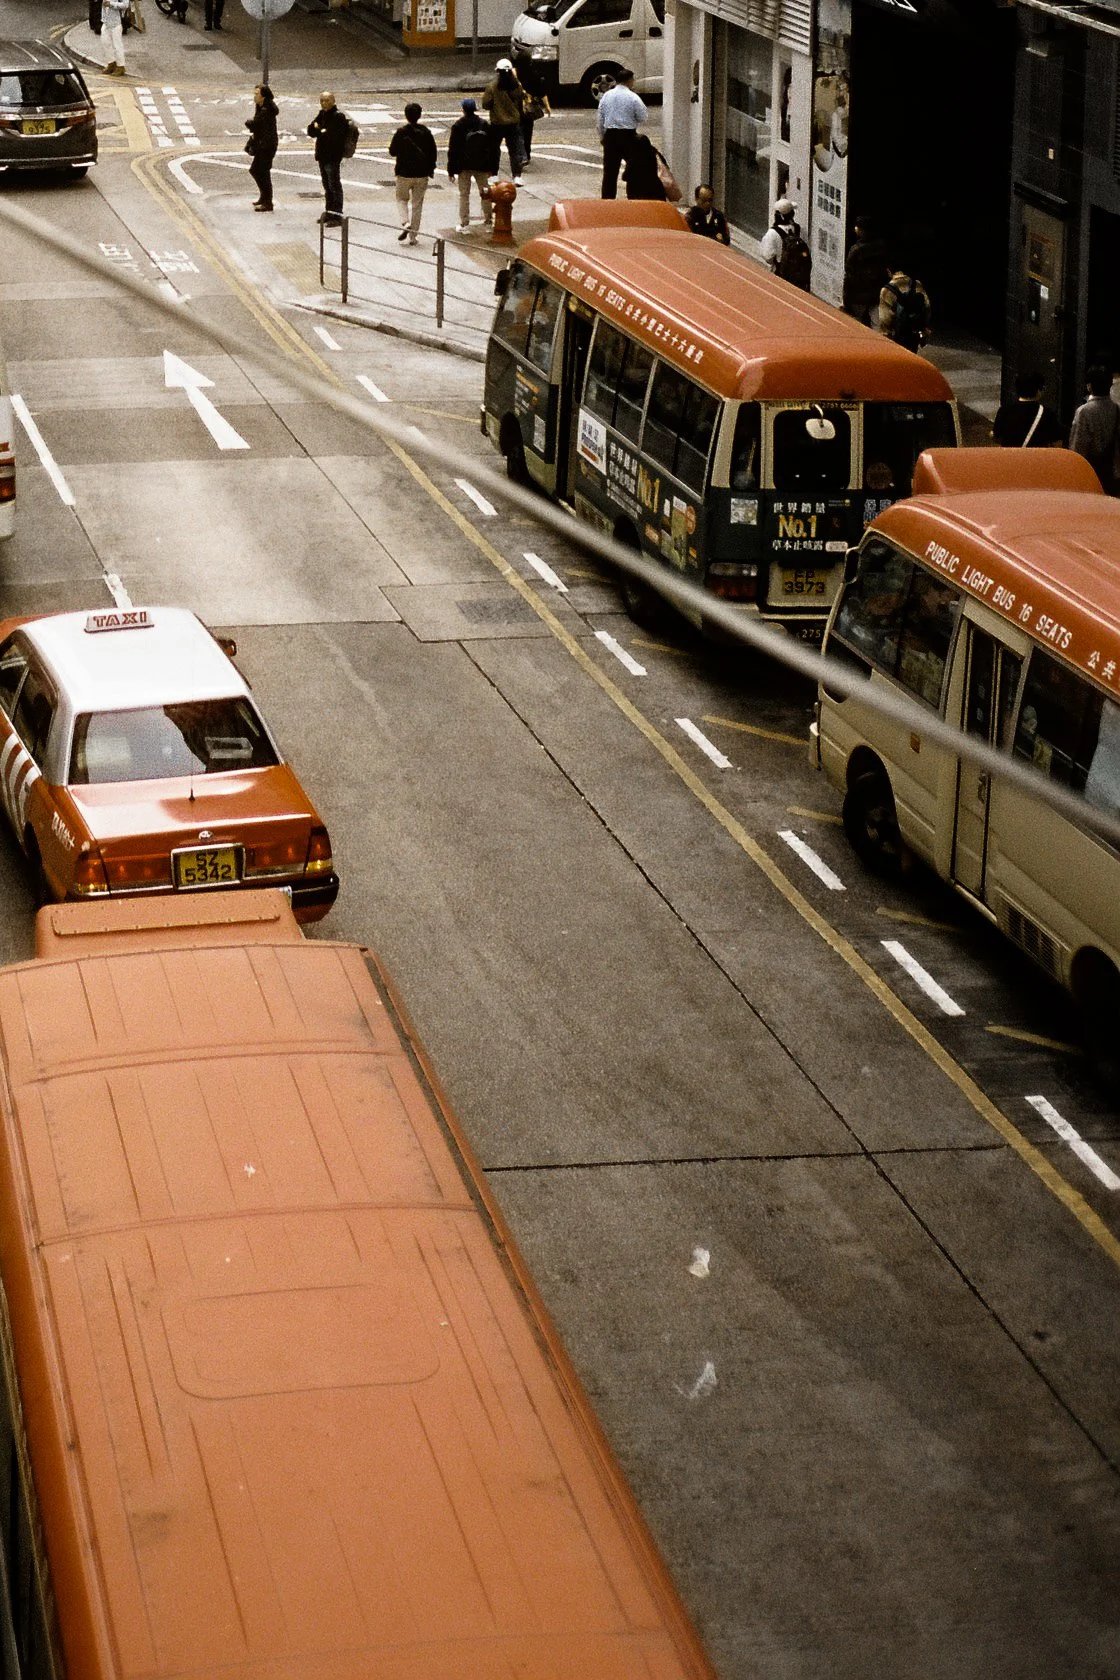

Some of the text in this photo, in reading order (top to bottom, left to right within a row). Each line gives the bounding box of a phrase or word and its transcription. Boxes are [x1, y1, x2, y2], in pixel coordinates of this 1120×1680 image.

[548, 253, 569, 273] PUBLIC
[566, 265, 586, 282] LIGHT
[583, 275, 598, 291] BUS
[605, 289, 626, 311] SEATS
[778, 514, 818, 538] No.1
[784, 581, 825, 593] 3973
[925, 541, 960, 573] PUBLIC
[961, 565, 994, 595] LIGHT
[992, 585, 1016, 611] BUS
[1018, 602, 1033, 622] 16
[1036, 614, 1073, 650] SEATS
[93, 610, 148, 628] TAXI
[195, 851, 218, 869] SZ
[184, 864, 232, 884] 5342
